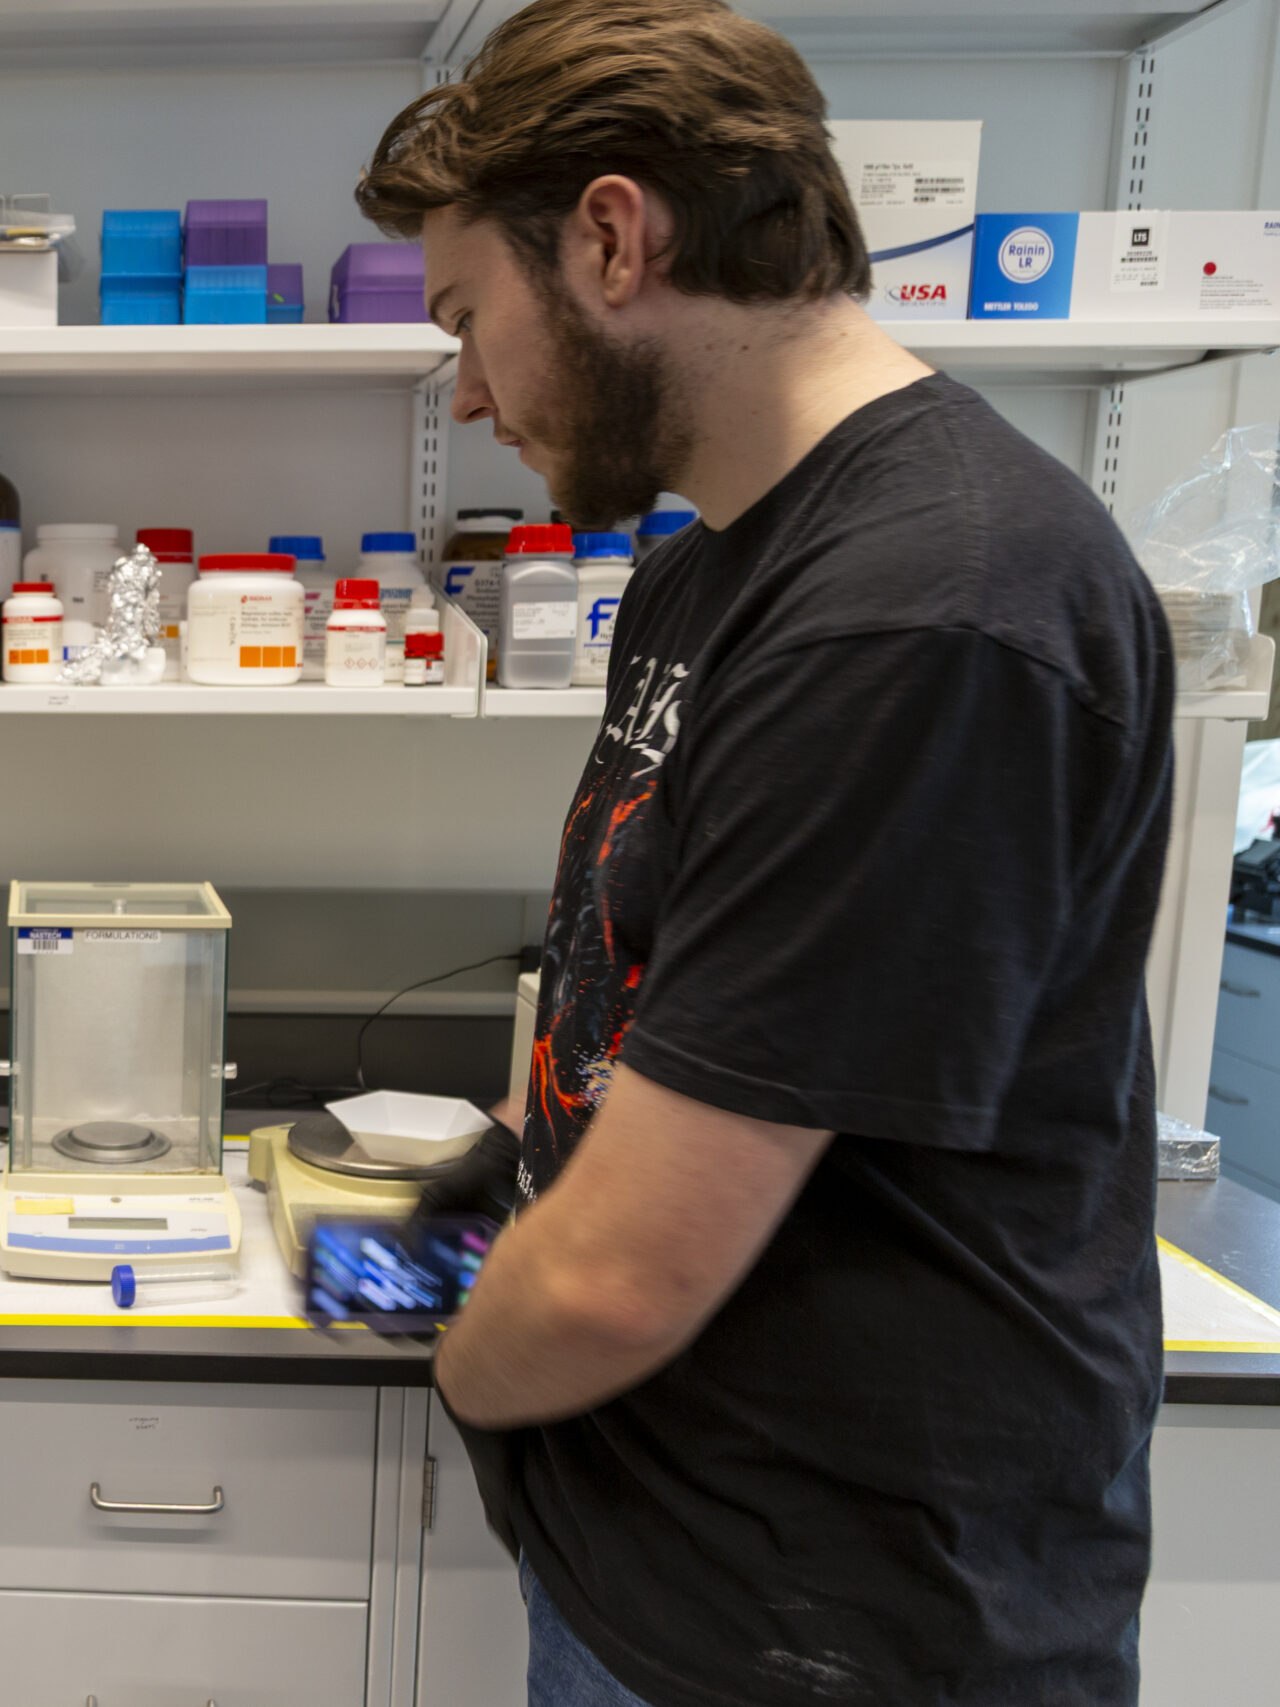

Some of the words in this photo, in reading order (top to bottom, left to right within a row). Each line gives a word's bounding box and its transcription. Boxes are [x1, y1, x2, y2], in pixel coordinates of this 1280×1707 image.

[1134, 232, 1147, 242] LTS
[1008, 244, 1045, 256] Rainin
[1018, 257, 1033, 268] LR
[900, 284, 947, 300] USA
[984, 302, 1011, 311] METTLER
[1014, 302, 1039, 311] TOLEDO
[86, 931, 159, 940] FORMULATIONS
